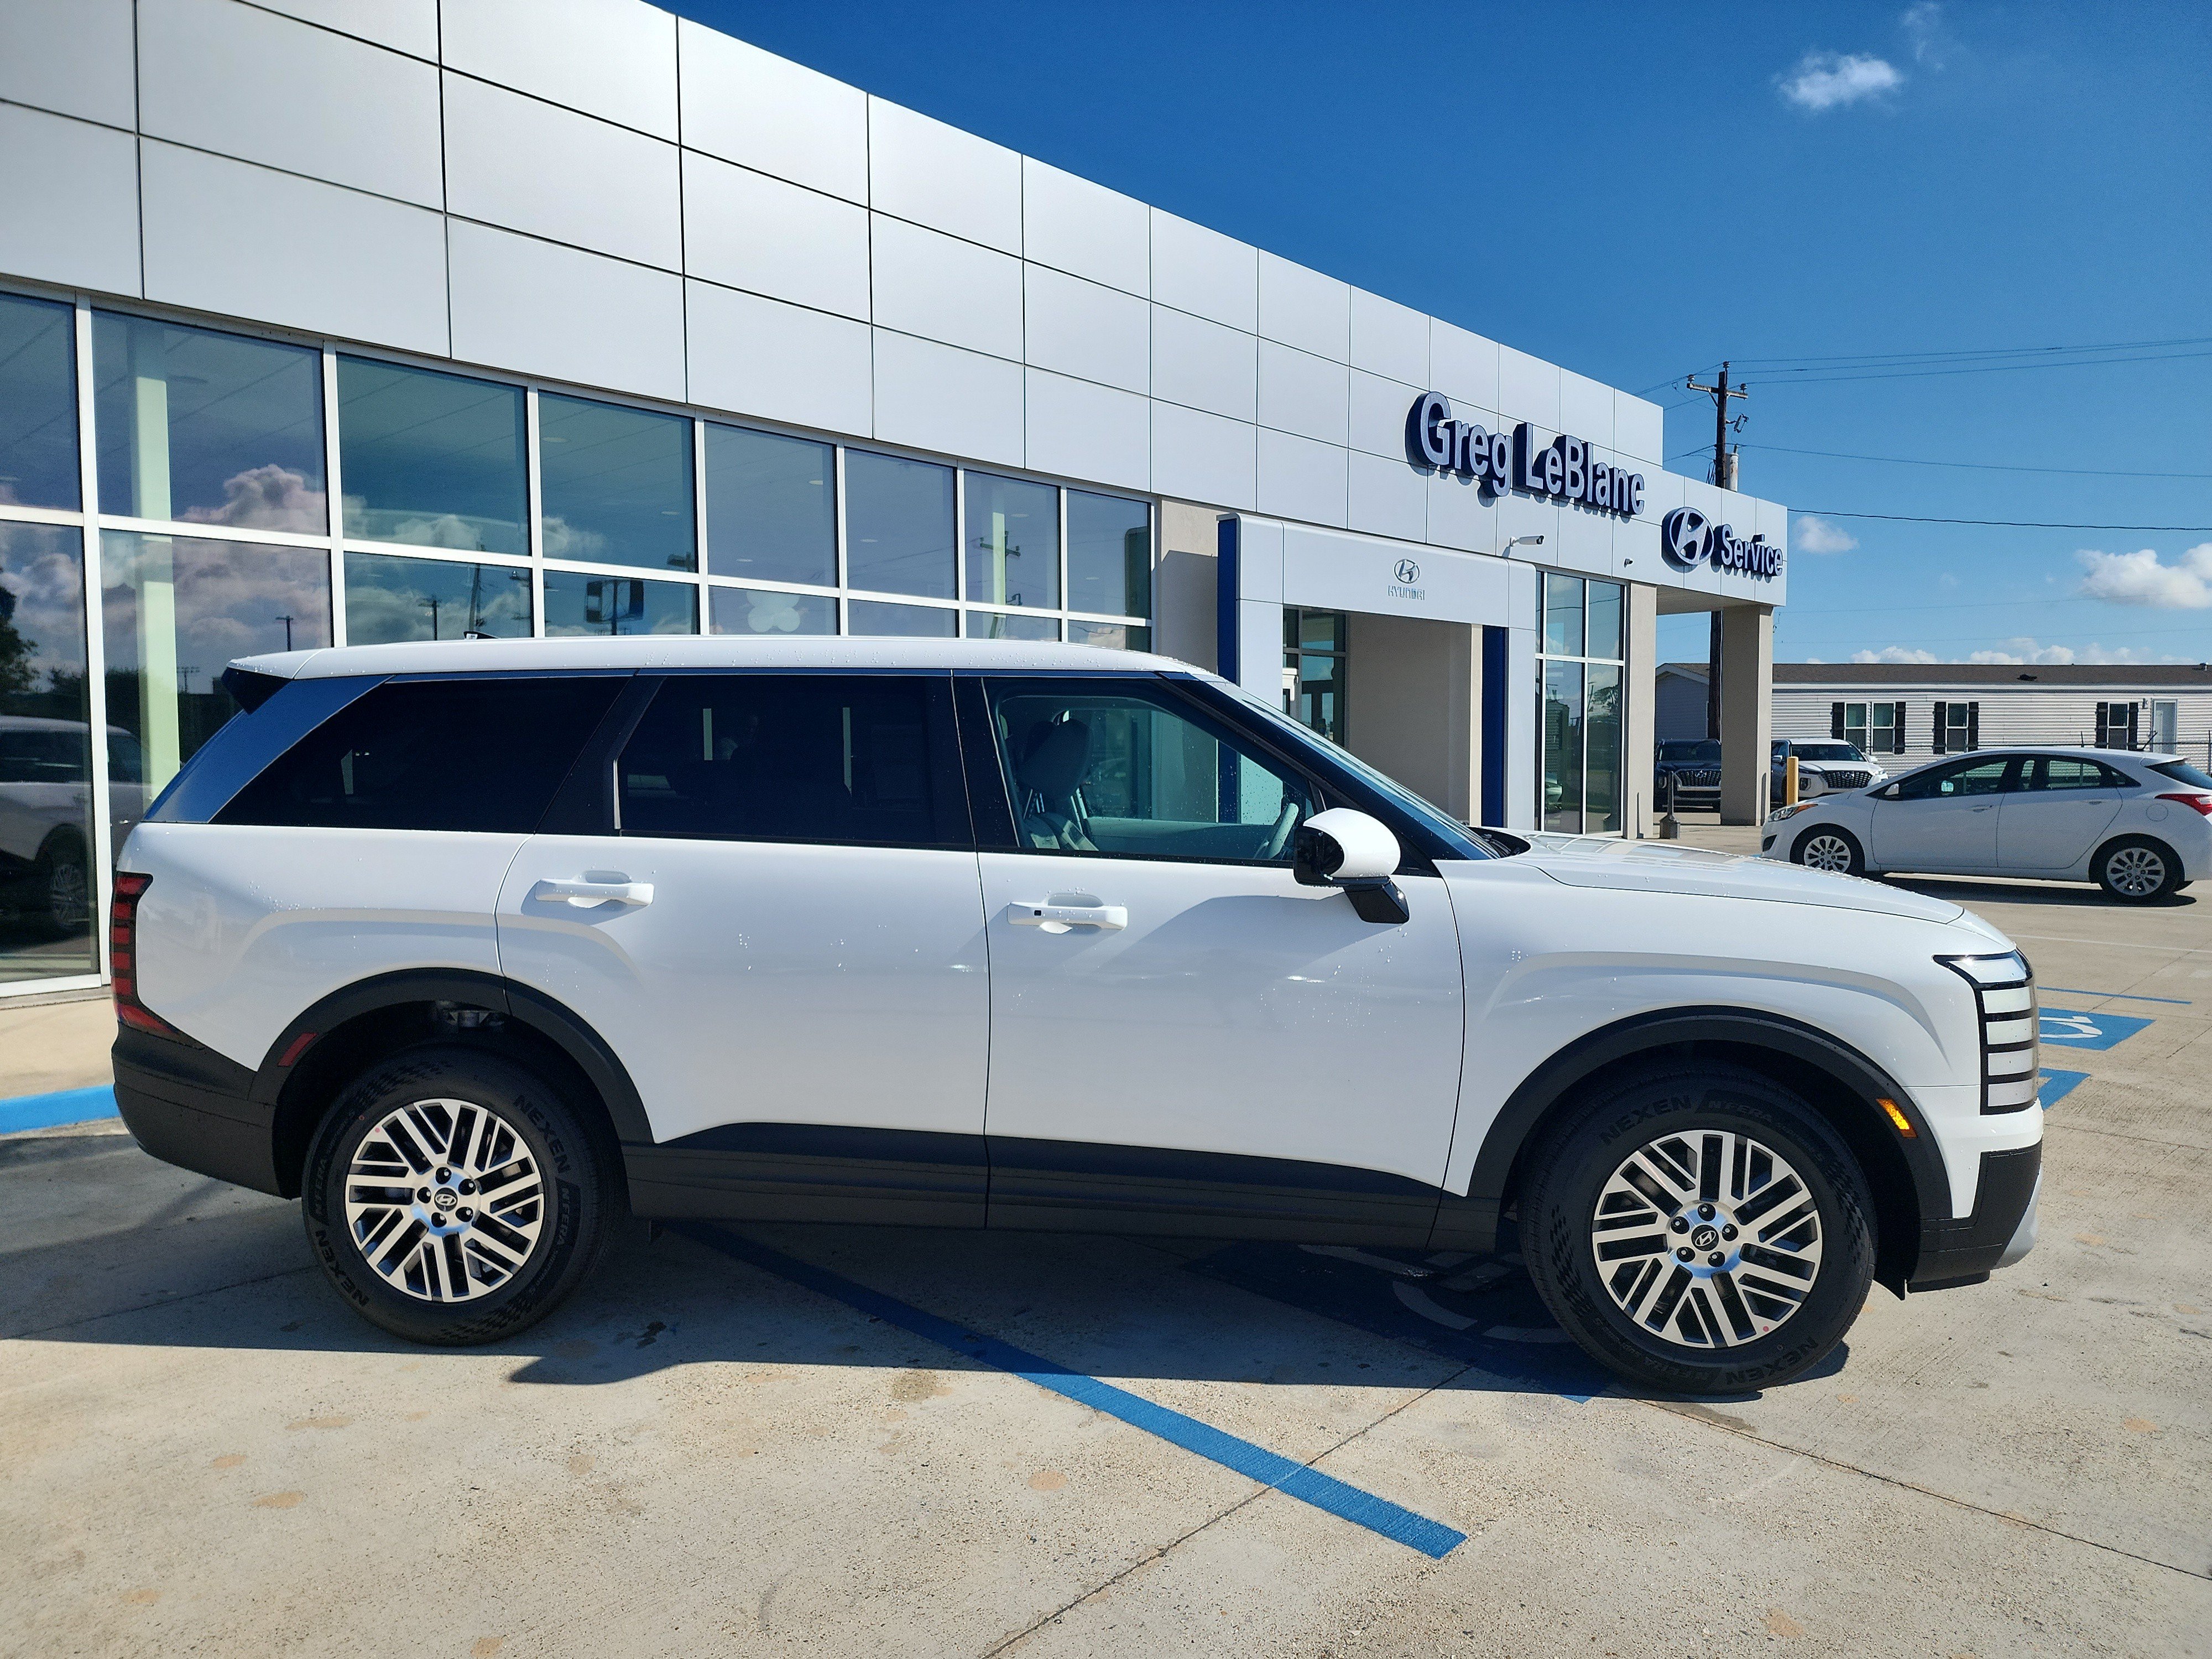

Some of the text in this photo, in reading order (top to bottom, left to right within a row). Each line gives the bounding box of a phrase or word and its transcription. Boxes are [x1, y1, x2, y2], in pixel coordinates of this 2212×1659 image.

[1405, 391, 1645, 515] Greg LeBlanc
[1714, 524, 1783, 577] Service
[1387, 585, 1425, 601] HYUNDAI
[513, 1094, 571, 1174] NEXEN
[1599, 1095, 1692, 1146] NEXEN
[315, 1229, 369, 1306] NEXEN
[1726, 1335, 1819, 1385] NEXEN
